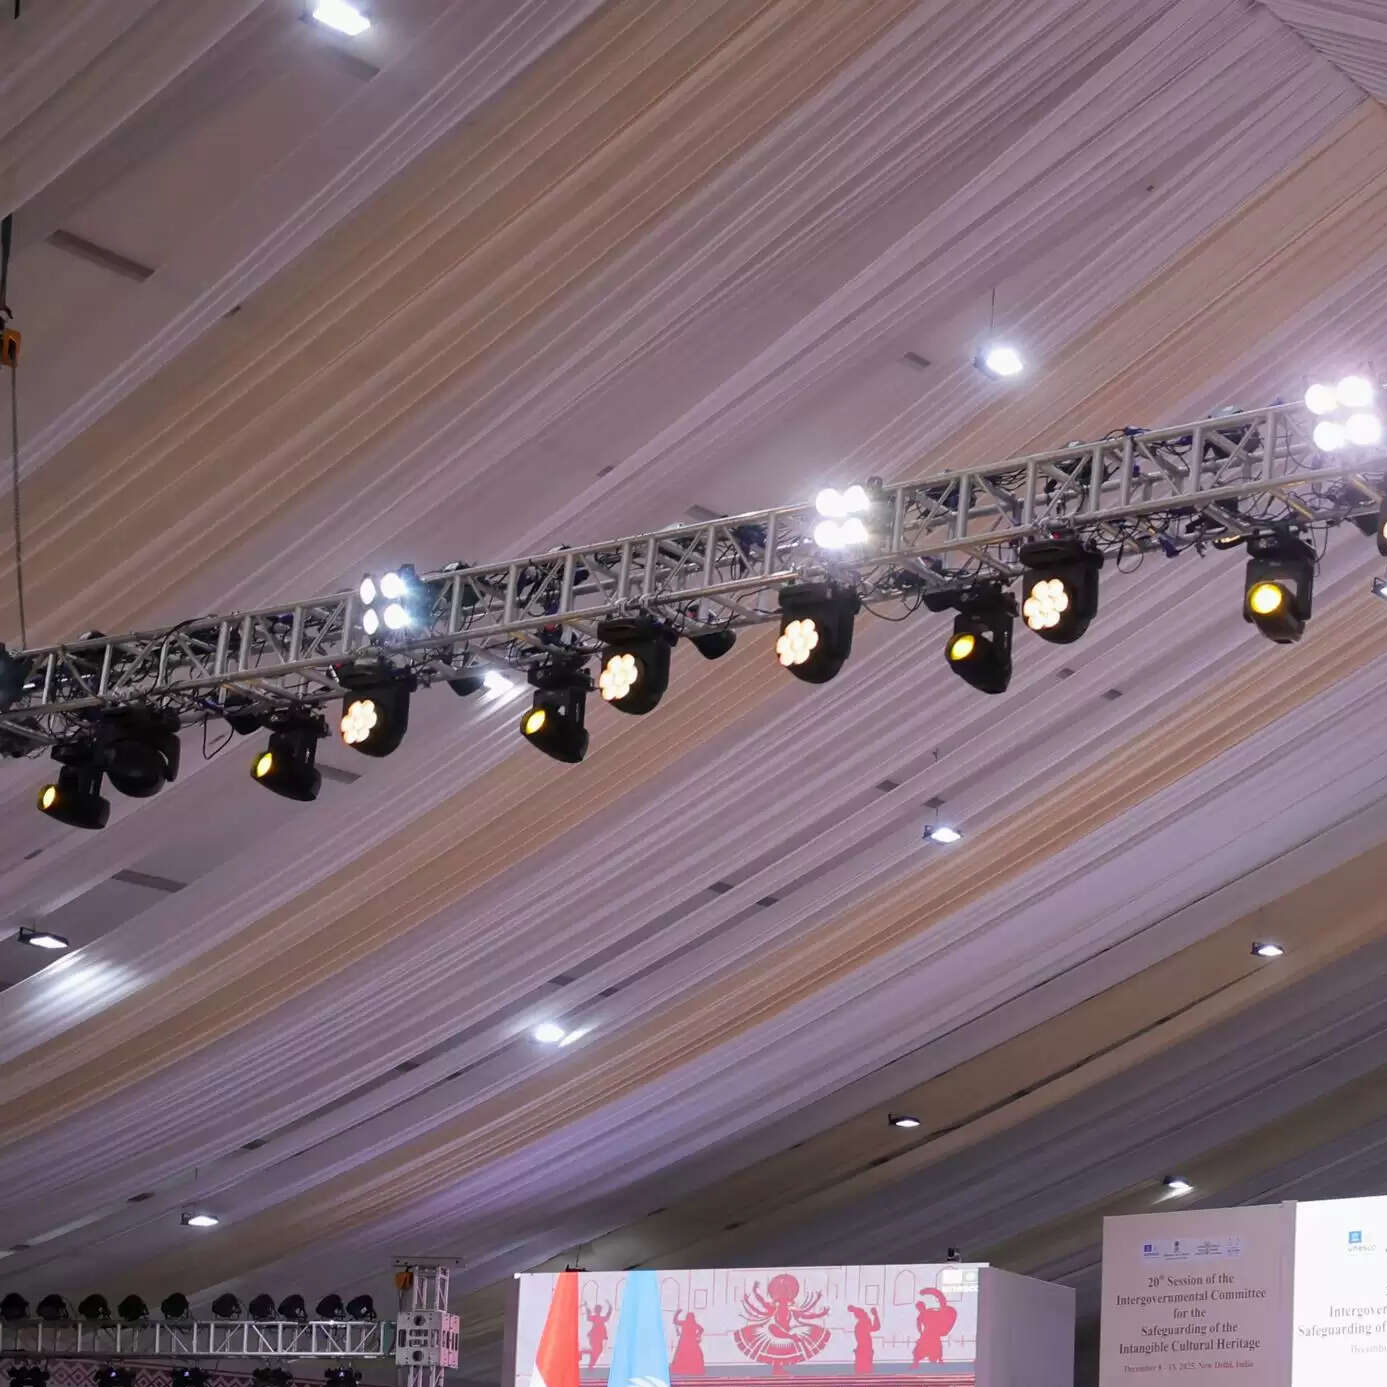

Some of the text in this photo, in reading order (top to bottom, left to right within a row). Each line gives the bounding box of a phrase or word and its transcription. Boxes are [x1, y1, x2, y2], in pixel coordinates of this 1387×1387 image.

[1167, 1274, 1203, 1288] Session
[1205, 1273, 1216, 1284] of
[1218, 1272, 1235, 1284] the
[1116, 1288, 1267, 1307] Intergovernmental Committee
[1173, 1307, 1206, 1319] for the
[1141, 1321, 1238, 1337] Safeguarding of the
[1298, 1323, 1372, 1338] Safeguarding
[1375, 1320, 1387, 1333] of
[1119, 1337, 1261, 1355] Intangible Cultural Heritage
